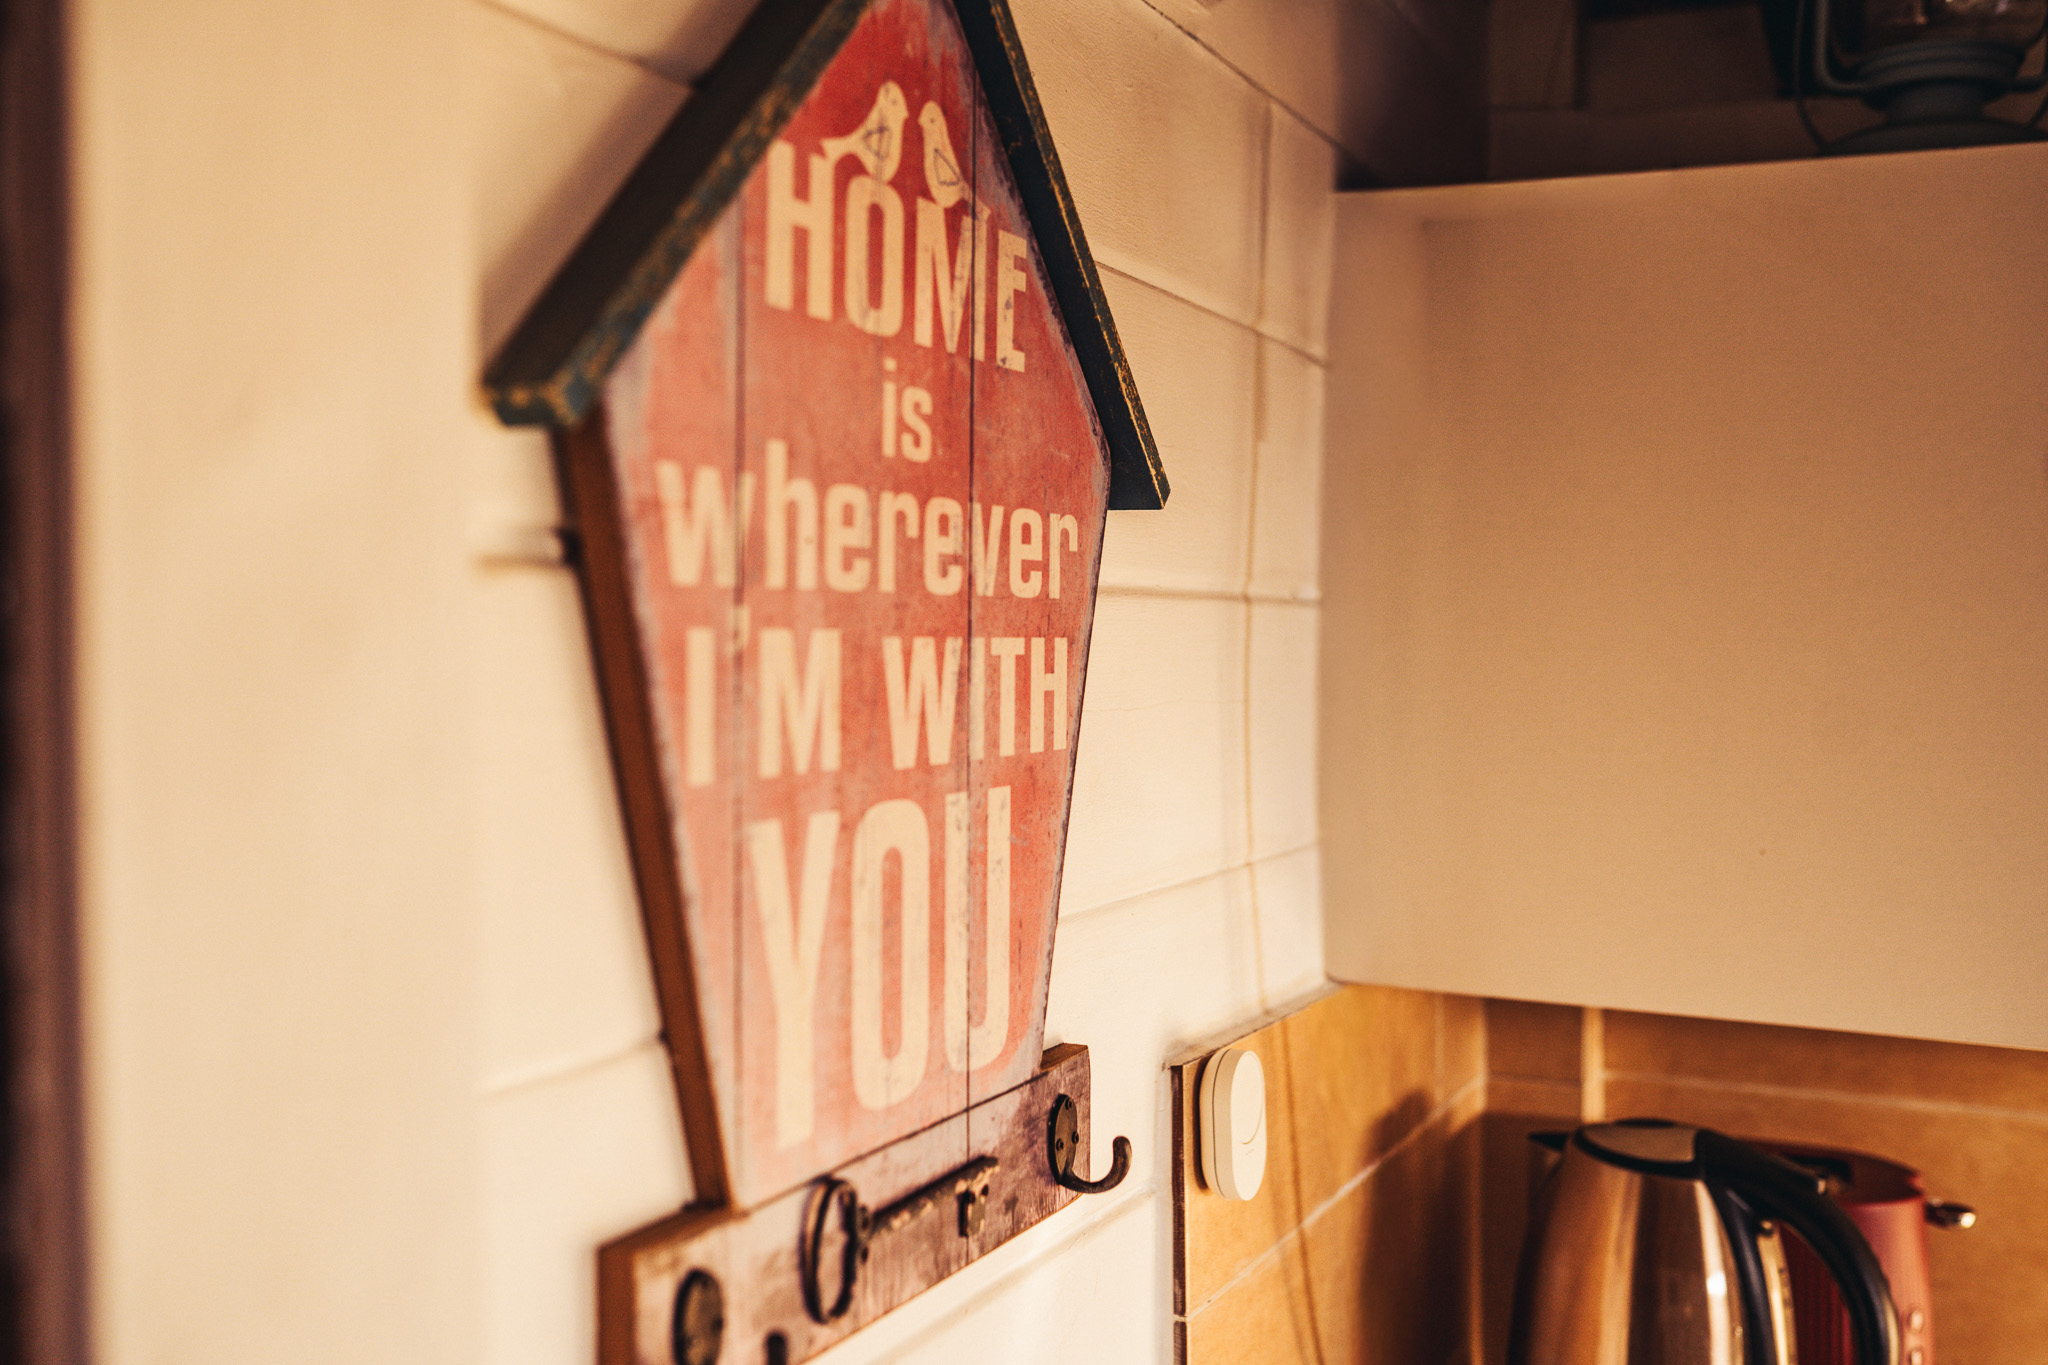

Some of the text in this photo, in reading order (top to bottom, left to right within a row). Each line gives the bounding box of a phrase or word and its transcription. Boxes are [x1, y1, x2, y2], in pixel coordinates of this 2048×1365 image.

[764, 139, 1028, 373] HOME
[881, 356, 933, 463] is
[655, 438, 1080, 600] wherever
[685, 603, 1069, 788] I'M WITH
[749, 785, 1012, 1150] YOU
